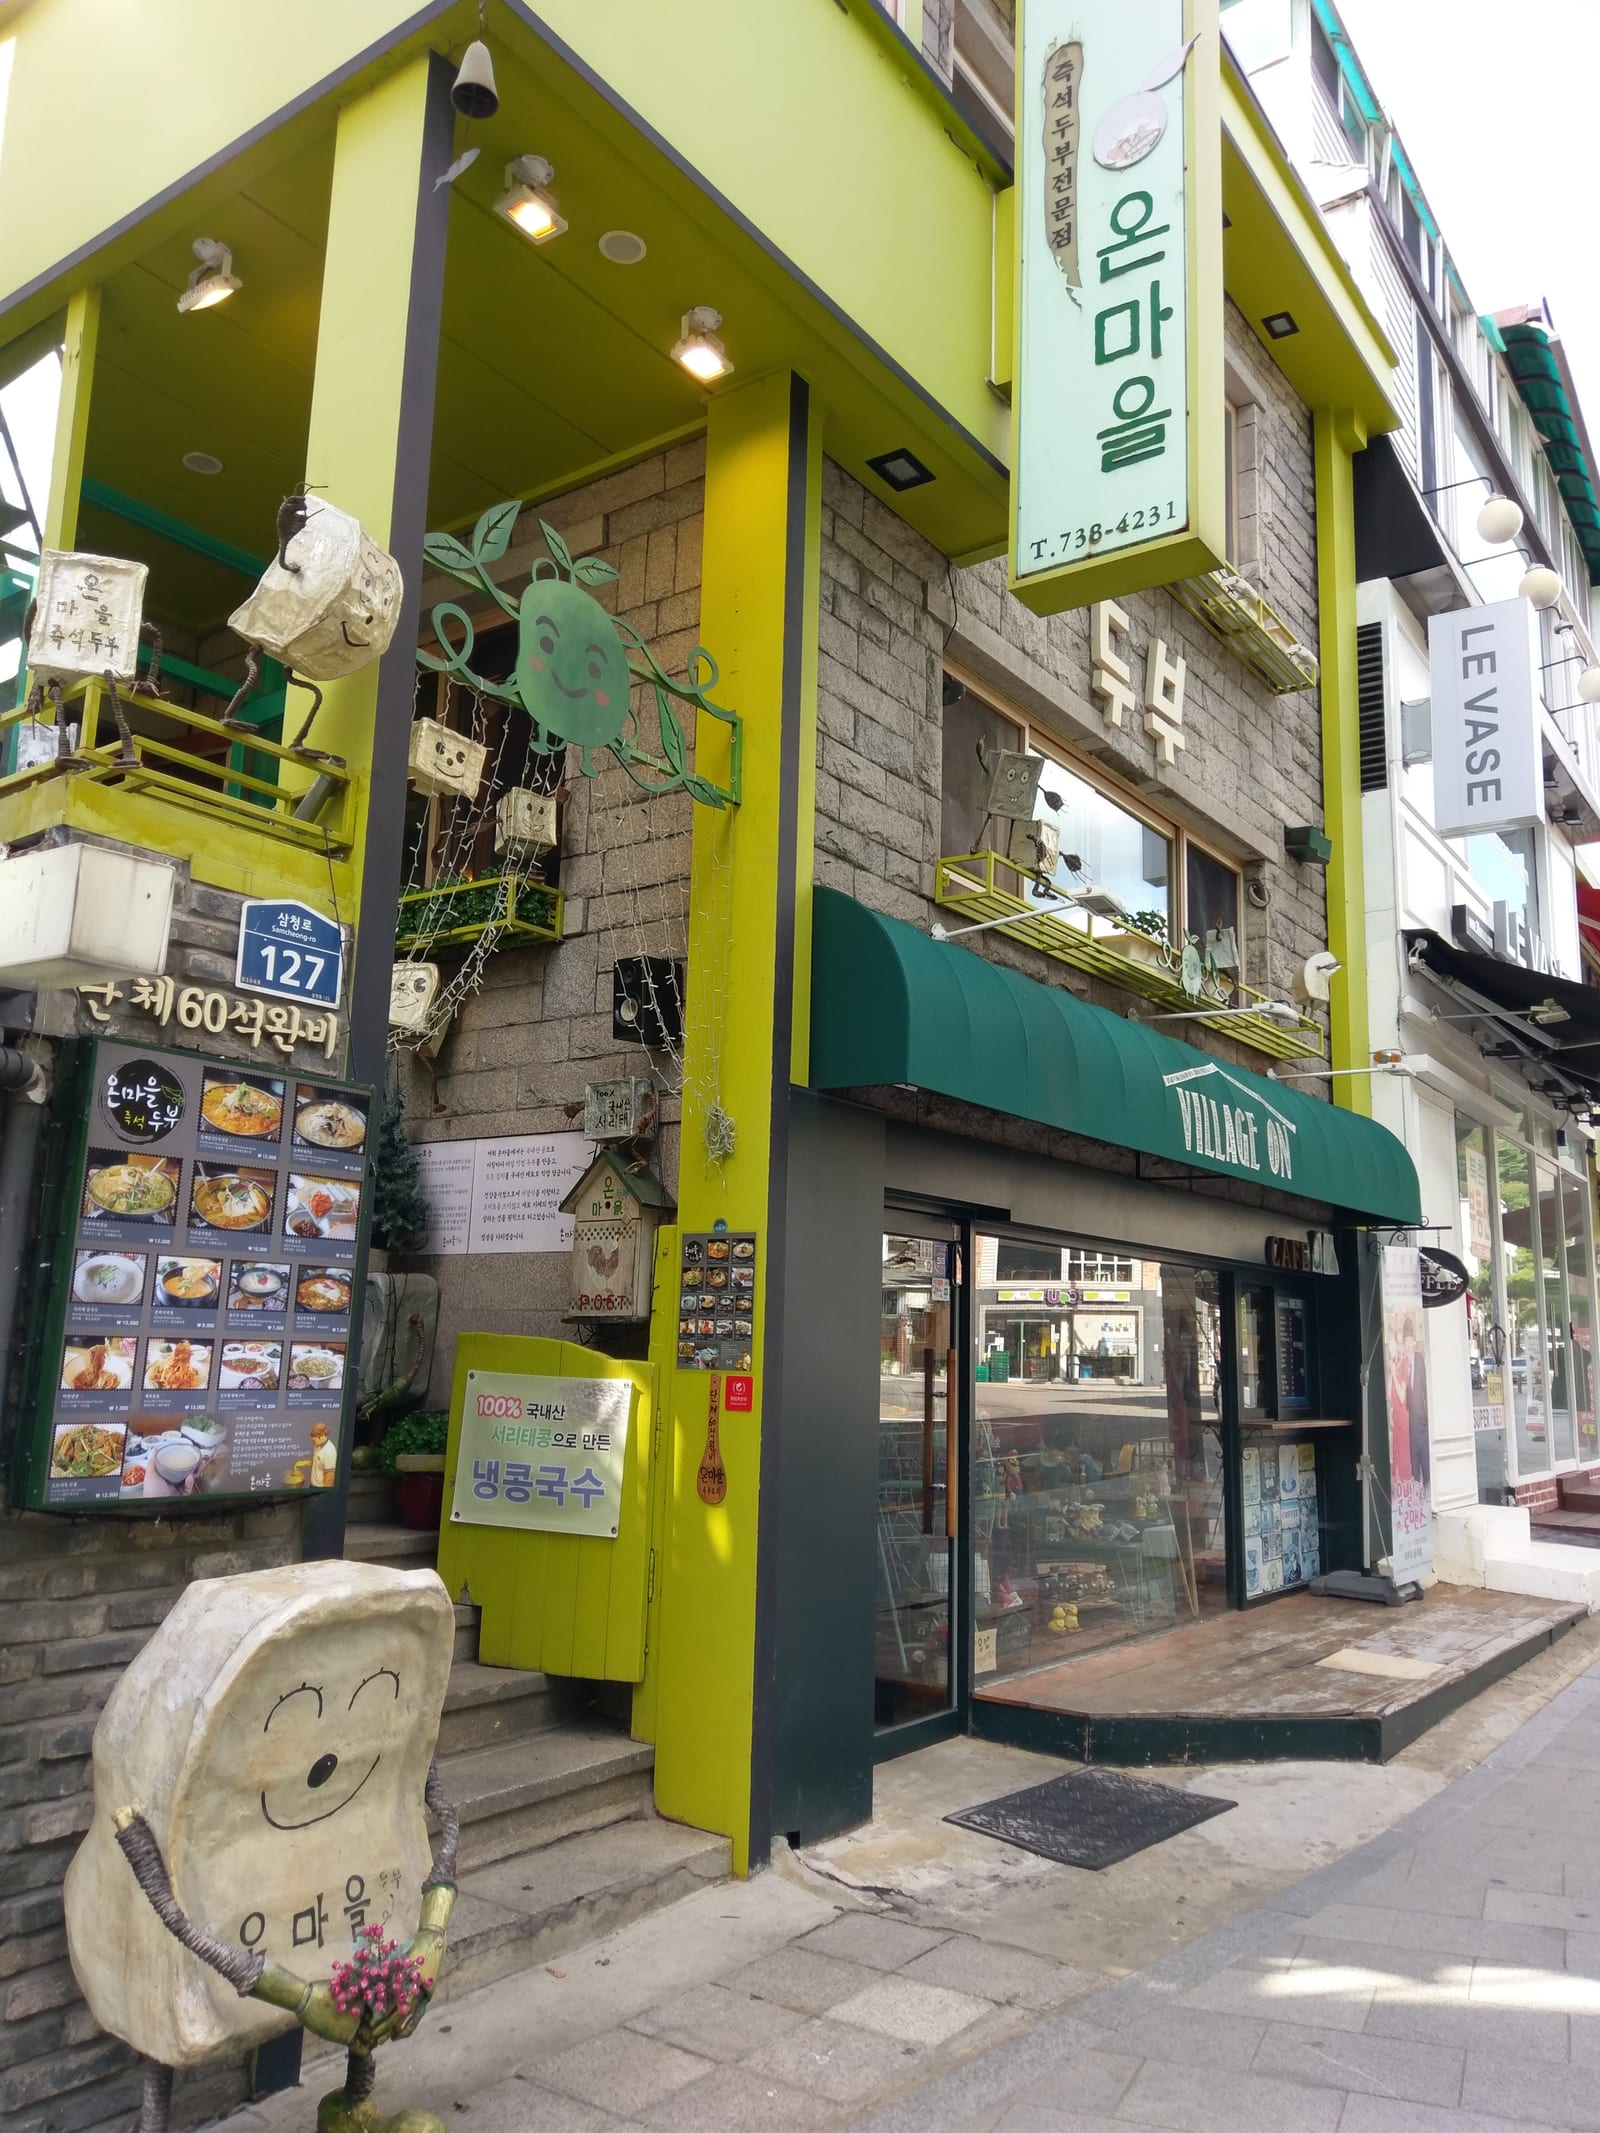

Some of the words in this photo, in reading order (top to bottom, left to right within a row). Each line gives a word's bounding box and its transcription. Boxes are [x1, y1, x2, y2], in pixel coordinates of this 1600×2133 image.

[1051, 59, 1076, 251] 즉석두부전문점
[1095, 190, 1174, 474] 온마을
[1030, 500, 1177, 561] T.738-4231
[50, 624, 119, 658] 즉석두부
[1461, 623, 1497, 680] LE
[1091, 599, 1187, 768] 두부
[1461, 686, 1503, 807] VASE
[271, 925, 317, 943] Samcheong-ro
[277, 912, 313, 932] 삼청로
[260, 945, 325, 990] 127
[107, 1074, 161, 1109] 온마을
[596, 1089, 615, 1101] 100%
[608, 1098, 631, 1115] 국내산
[148, 1105, 180, 1132] 두부
[595, 1112, 629, 1130] 서리태
[1176, 1086, 1260, 1171] VILLAGE
[1266, 1118, 1292, 1180] ON
[1268, 1236, 1311, 1271] CAFE
[476, 1394, 522, 1419] 100%
[526, 1402, 567, 1421] 국내산
[491, 1424, 578, 1449] 서리태콩으로
[582, 1433, 612, 1451] 만든
[250, 1472, 272, 1492] 온마을
[472, 1460, 606, 1509] 냉콩국수
